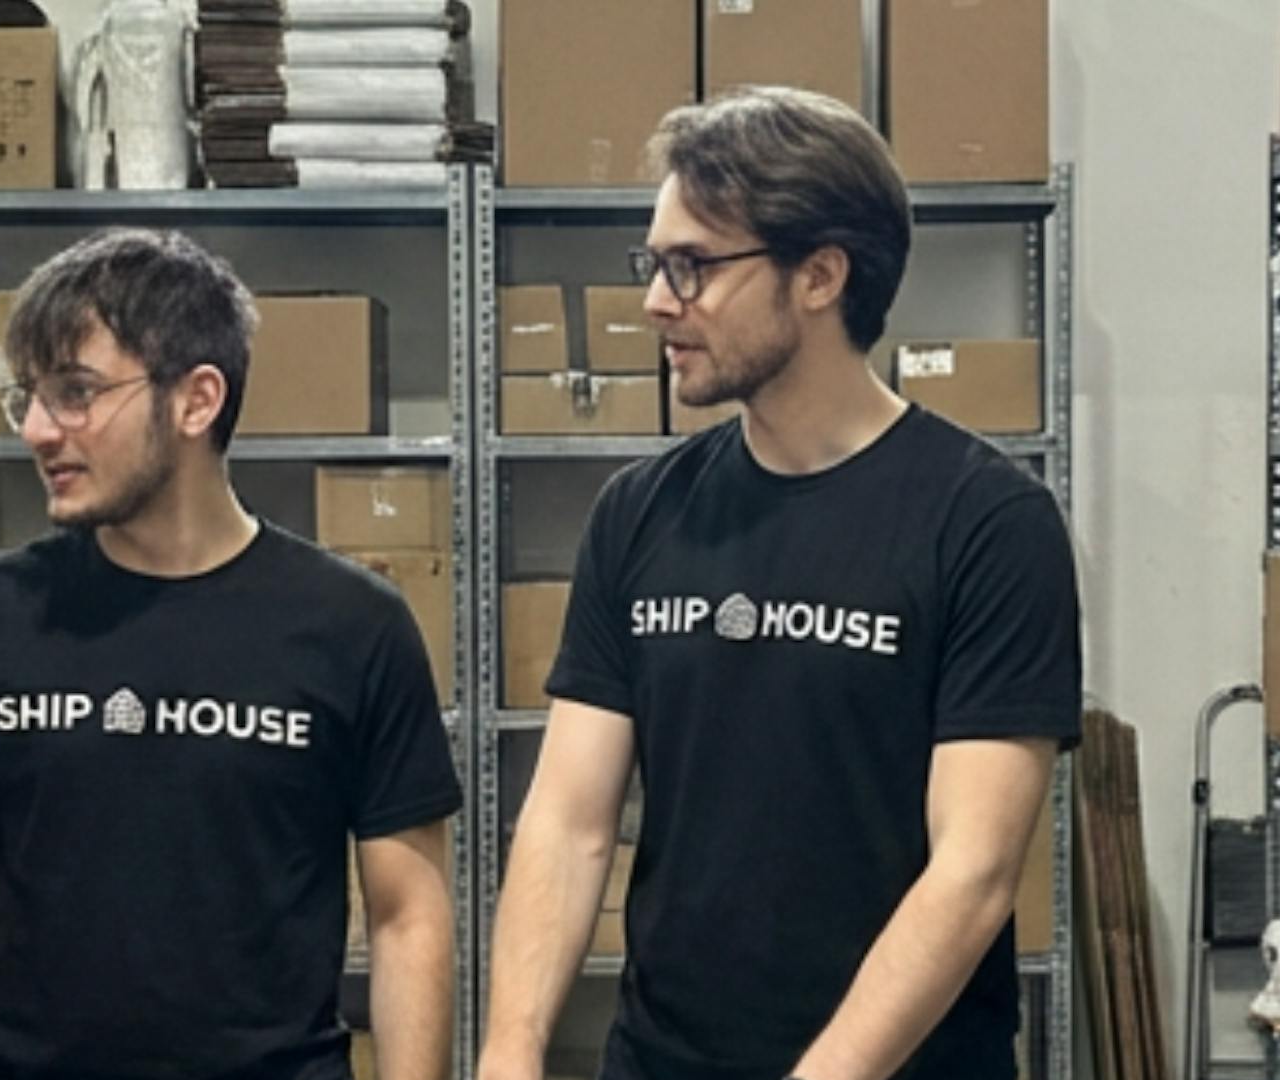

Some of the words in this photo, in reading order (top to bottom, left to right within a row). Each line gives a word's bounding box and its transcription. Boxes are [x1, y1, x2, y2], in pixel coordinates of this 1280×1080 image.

[631, 596, 710, 636] SHIP
[761, 600, 901, 654] HOUSE
[155, 698, 312, 747] HOUSE
